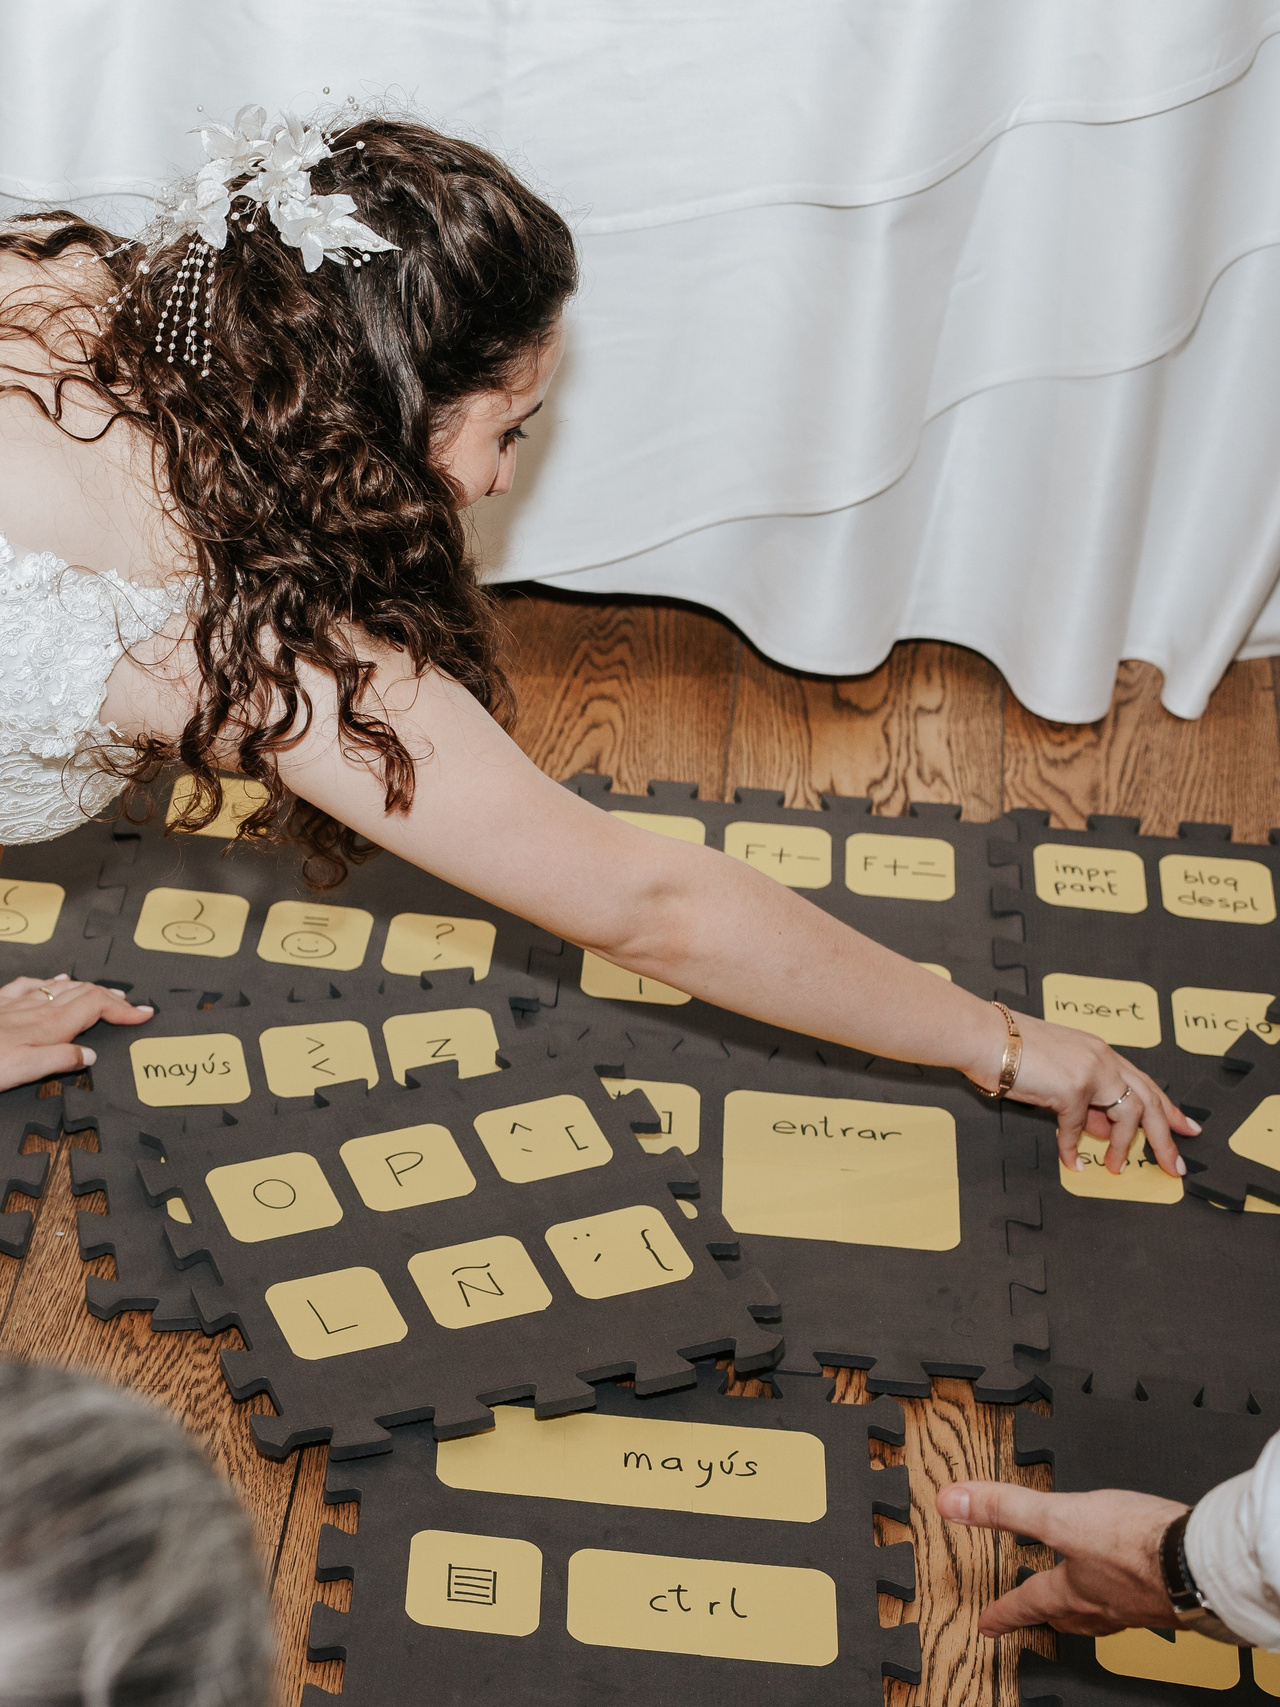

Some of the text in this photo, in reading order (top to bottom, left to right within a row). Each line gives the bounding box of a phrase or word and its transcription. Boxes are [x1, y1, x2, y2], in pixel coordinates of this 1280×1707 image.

[1054, 859, 1117, 883] impr
[1183, 869, 1239, 893] bloq
[1053, 880, 1120, 897] pant
[1177, 890, 1260, 914] despl
[1054, 995, 1146, 1022] insert
[1183, 1009, 1274, 1036] inicio
[142, 1052, 232, 1087] mayús
[772, 1115, 903, 1142] entrar
[384, 1150, 424, 1187] P
[252, 1178, 297, 1210] O
[451, 1262, 505, 1308] Ñ
[306, 1299, 359, 1335] L
[622, 1449, 759, 1489] mayús
[649, 1583, 749, 1619] ctrl
